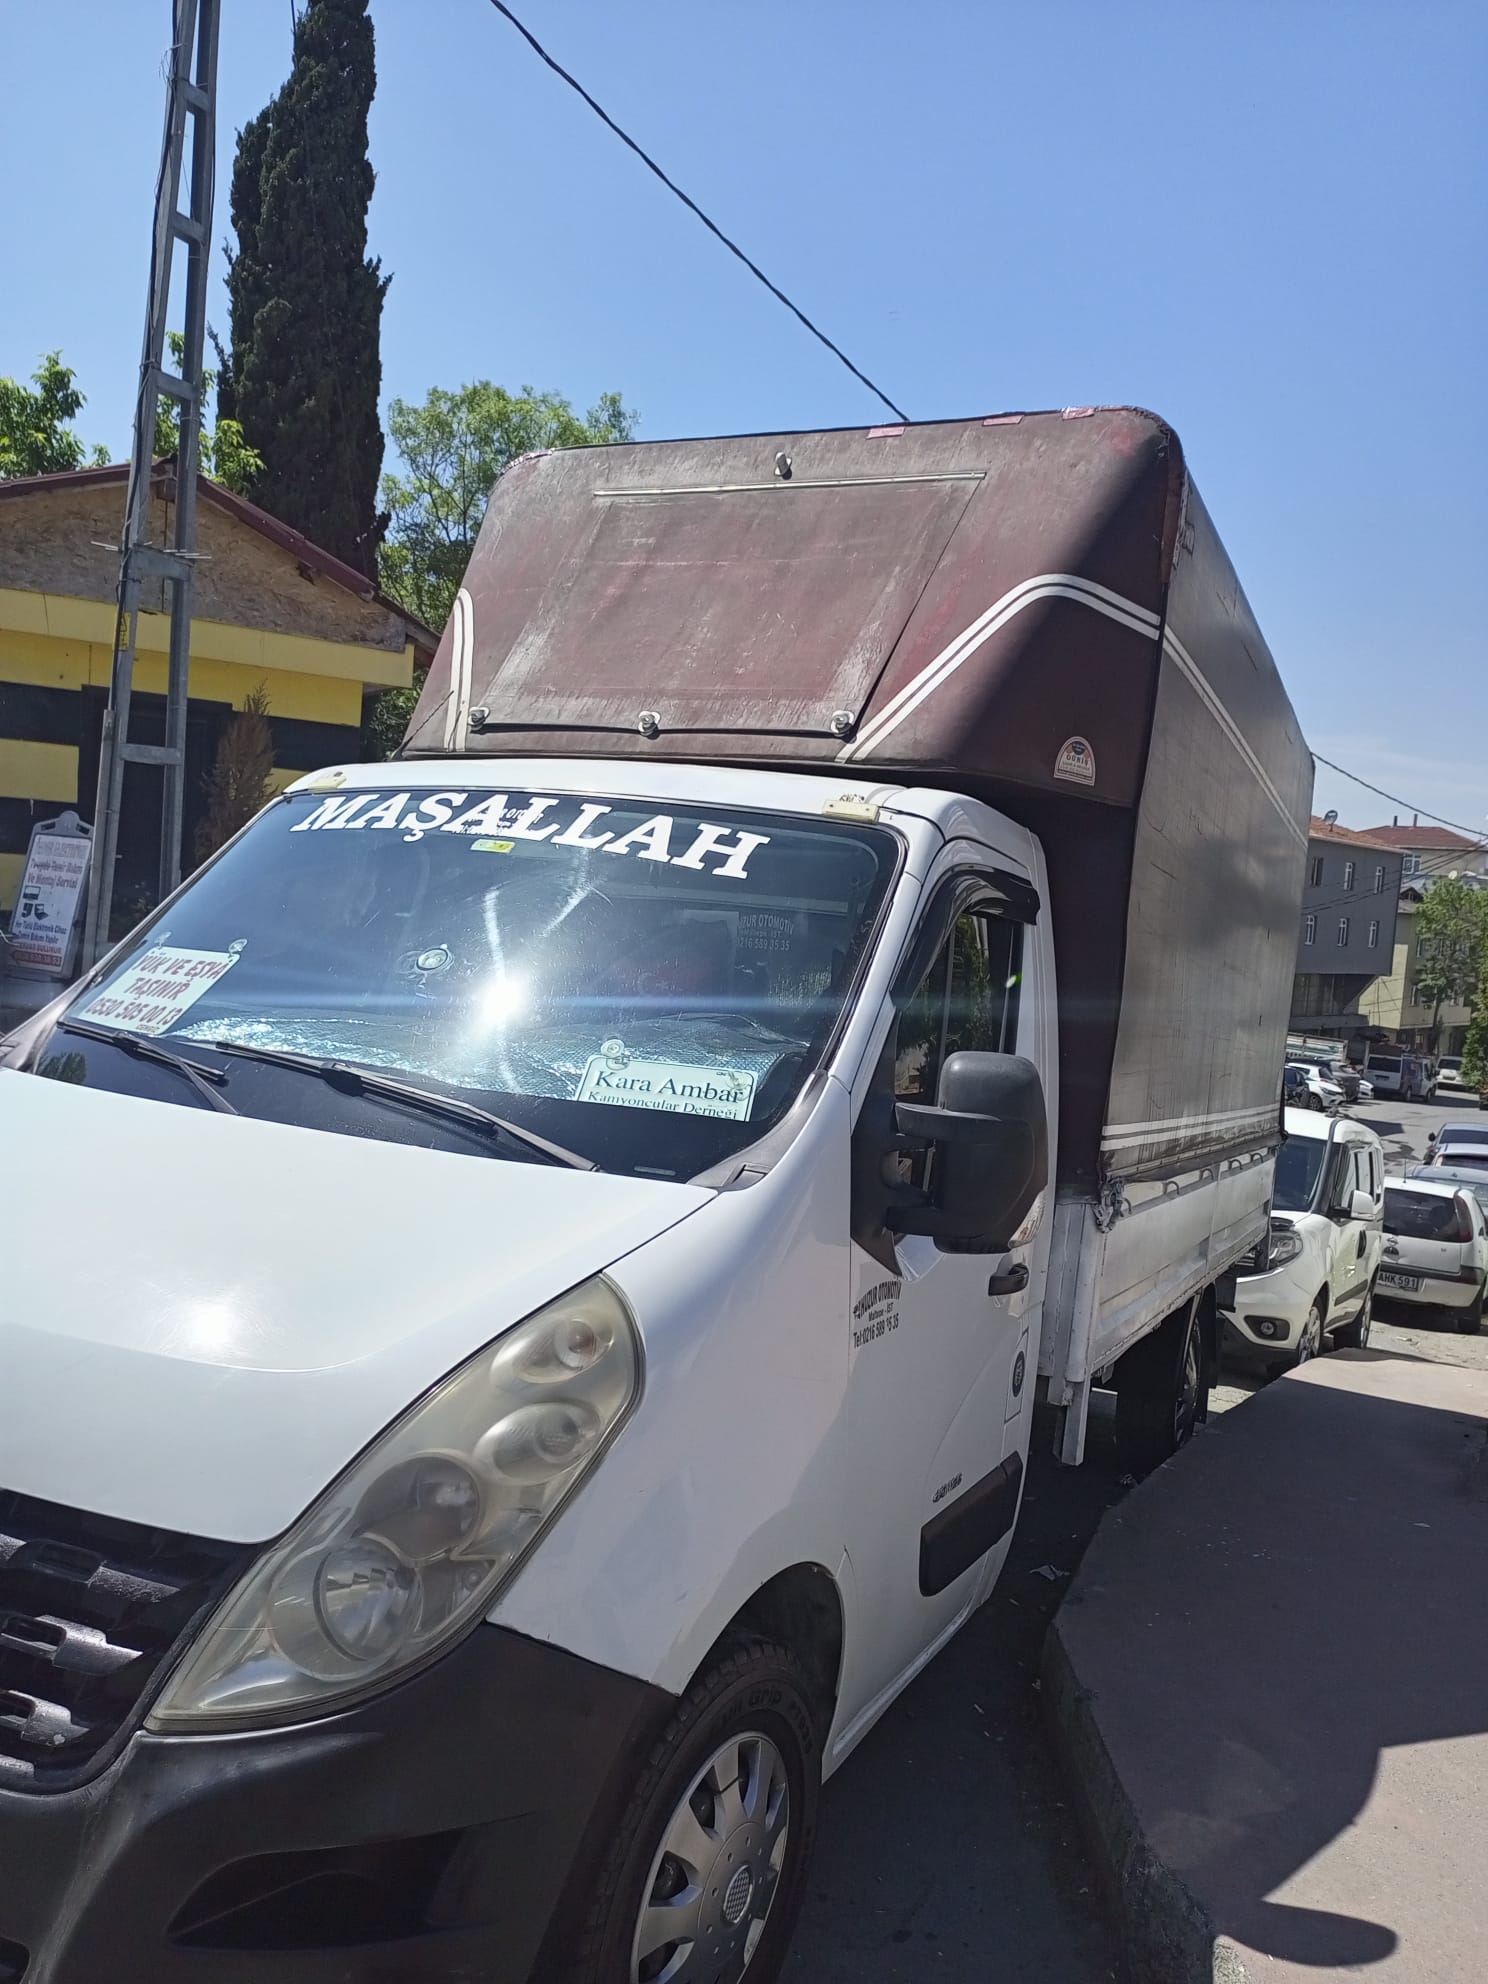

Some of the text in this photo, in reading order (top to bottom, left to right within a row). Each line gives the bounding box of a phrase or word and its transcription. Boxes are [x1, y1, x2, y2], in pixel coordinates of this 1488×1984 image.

[289, 791, 770, 879] MAŞALLAH
[132, 952, 230, 981] YÜK VE EŞYA
[124, 977, 191, 1001] TAŞINIR
[114, 1001, 149, 1021] 505
[139, 1005, 168, 1024] 00
[156, 1007, 183, 1026] 13
[594, 1070, 744, 1104] Kara Ambar
[1397, 1275, 1417, 1289] 591
